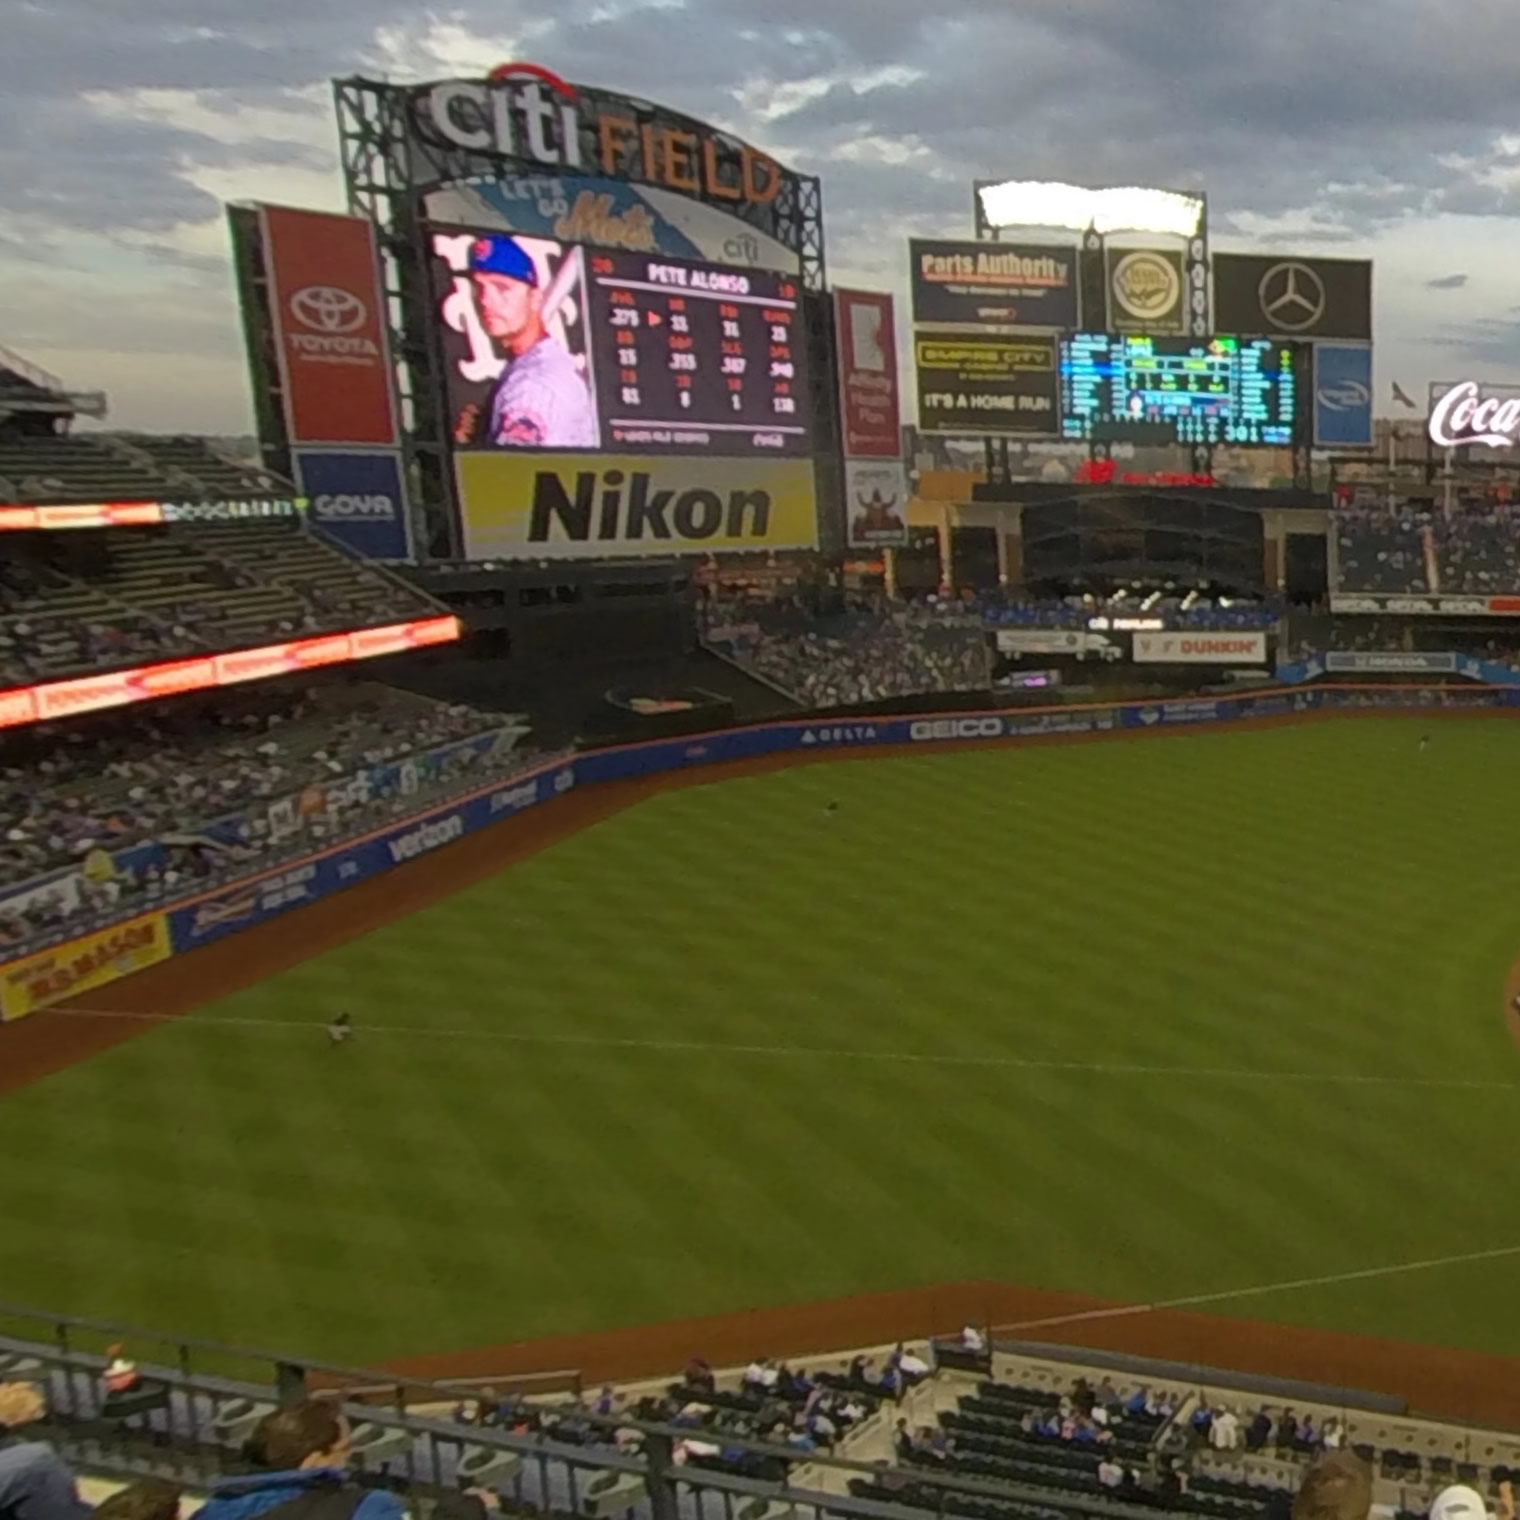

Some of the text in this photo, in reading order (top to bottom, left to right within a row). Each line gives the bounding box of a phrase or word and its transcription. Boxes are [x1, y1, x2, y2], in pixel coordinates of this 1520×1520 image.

[430, 80, 783, 205] citi FIELD
[500, 176, 564, 200] LET'S
[537, 198, 568, 217] GO
[553, 190, 657, 252] Mets
[723, 238, 758, 262] citi
[921, 252, 1068, 279] Parts Authority
[647, 263, 687, 287] PETE
[690, 271, 750, 295] ALONSO
[288, 333, 379, 356] TOYOTA
[925, 350, 1046, 363] EMPIRE CITY
[924, 393, 1052, 411] IT'S A HOME RUN
[314, 494, 394, 515] GOYA
[528, 469, 771, 542] Nikon
[1369, 656, 1428, 668] HONDA
[819, 725, 876, 741] DELTA
[910, 718, 1001, 741] GEICO
[388, 814, 464, 862] verizon
